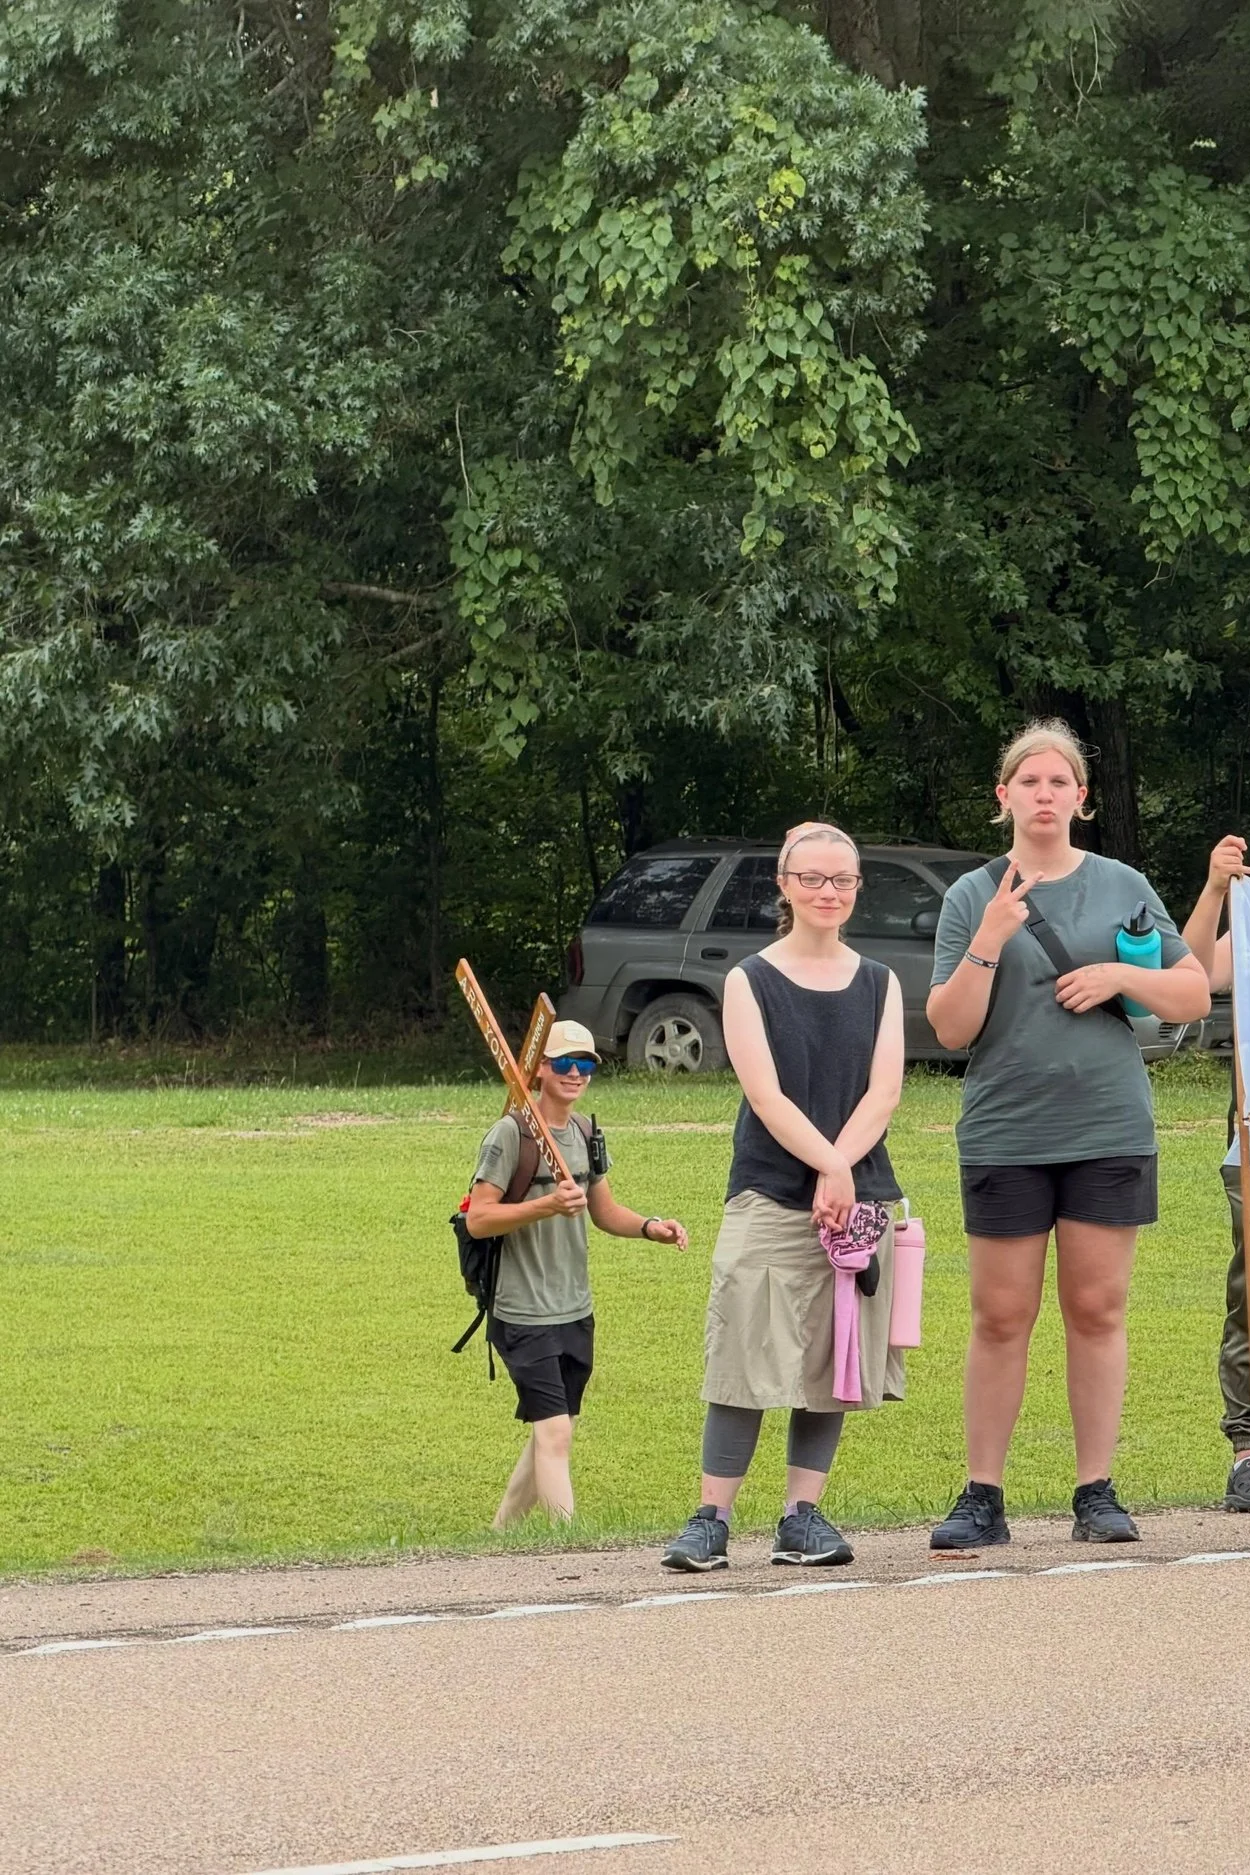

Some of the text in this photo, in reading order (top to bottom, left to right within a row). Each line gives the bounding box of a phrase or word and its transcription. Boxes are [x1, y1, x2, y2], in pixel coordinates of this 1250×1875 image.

[458, 976, 562, 1181] ARE YOU READY
